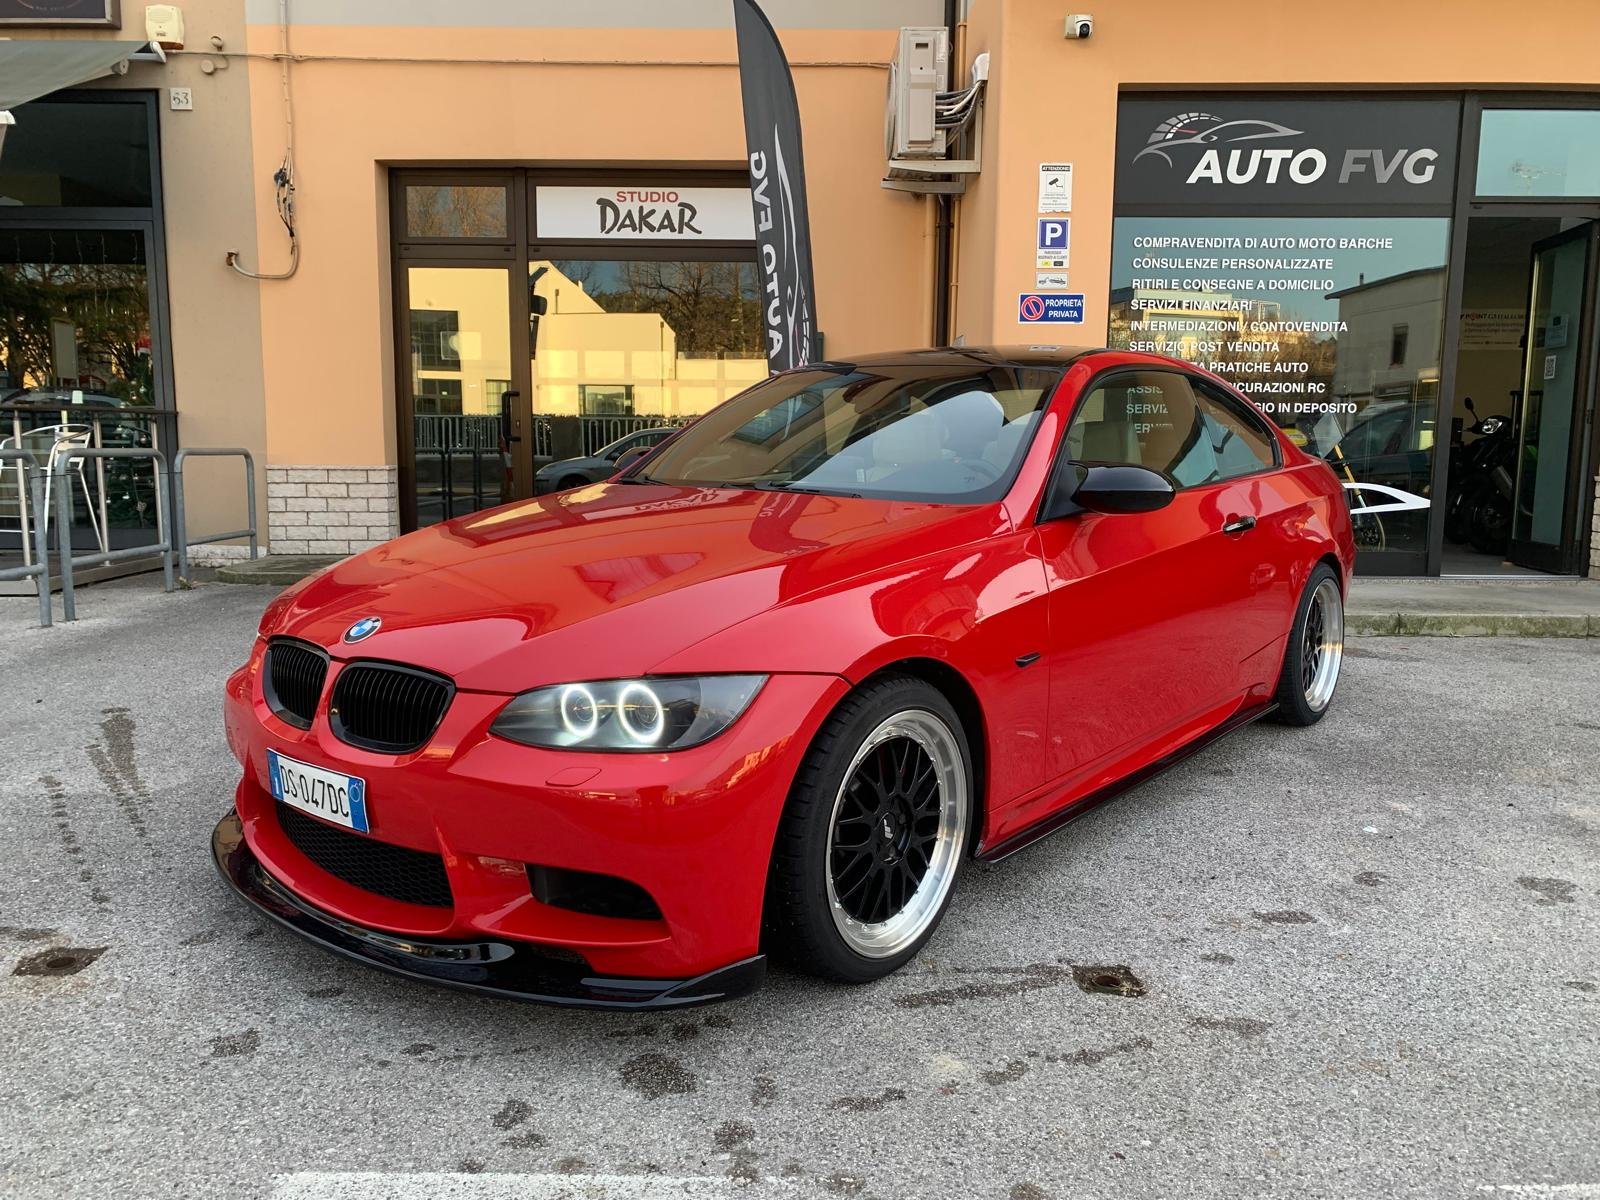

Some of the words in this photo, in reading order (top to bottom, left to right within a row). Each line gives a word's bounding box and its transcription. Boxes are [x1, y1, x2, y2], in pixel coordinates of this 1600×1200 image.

[1185, 148, 1327, 185] AUTO
[1338, 148, 1439, 185] FVG
[616, 190, 679, 203] STUDIO
[596, 197, 703, 235] DAKAR
[1045, 222, 1063, 246] P
[1133, 236, 1241, 249] COMPRAVENDITA
[1244, 237, 1258, 249] DI
[1259, 237, 1296, 249] AUTO
[1298, 238, 1336, 249] MOTO
[1339, 238, 1393, 249] BARCHE
[1132, 257, 1218, 269] CONSULENZE
[1221, 258, 1333, 270] PERSONALIZZATE
[1132, 278, 1168, 290] RITIRI
[1171, 279, 1179, 290] E
[1182, 279, 1254, 291] CONSEGNE
[1256, 279, 1266, 291] A
[1269, 279, 1335, 291] DOMICILIO
[1130, 299, 1180, 311] SERVIZI
[1182, 299, 1252, 312] FINANZIARI
[1048, 310, 1079, 318] PRIVATA
[1130, 320, 1240, 332] INTERMEDIAZIONI
[1250, 320, 1349, 333] CONTOVENDITA
[1129, 341, 1186, 353] SERVIZIO
[1191, 341, 1223, 353] POST
[1227, 341, 1280, 353] VENDITA
[1209, 361, 1271, 374] PRATICHE
[1273, 362, 1309, 374] AUTO
[1307, 382, 1326, 394] RC
[1277, 402, 1291, 414] IN
[1294, 402, 1358, 415] DEPOSITO
[280, 765, 298, 798] DS
[299, 774, 349, 818] 047DC
